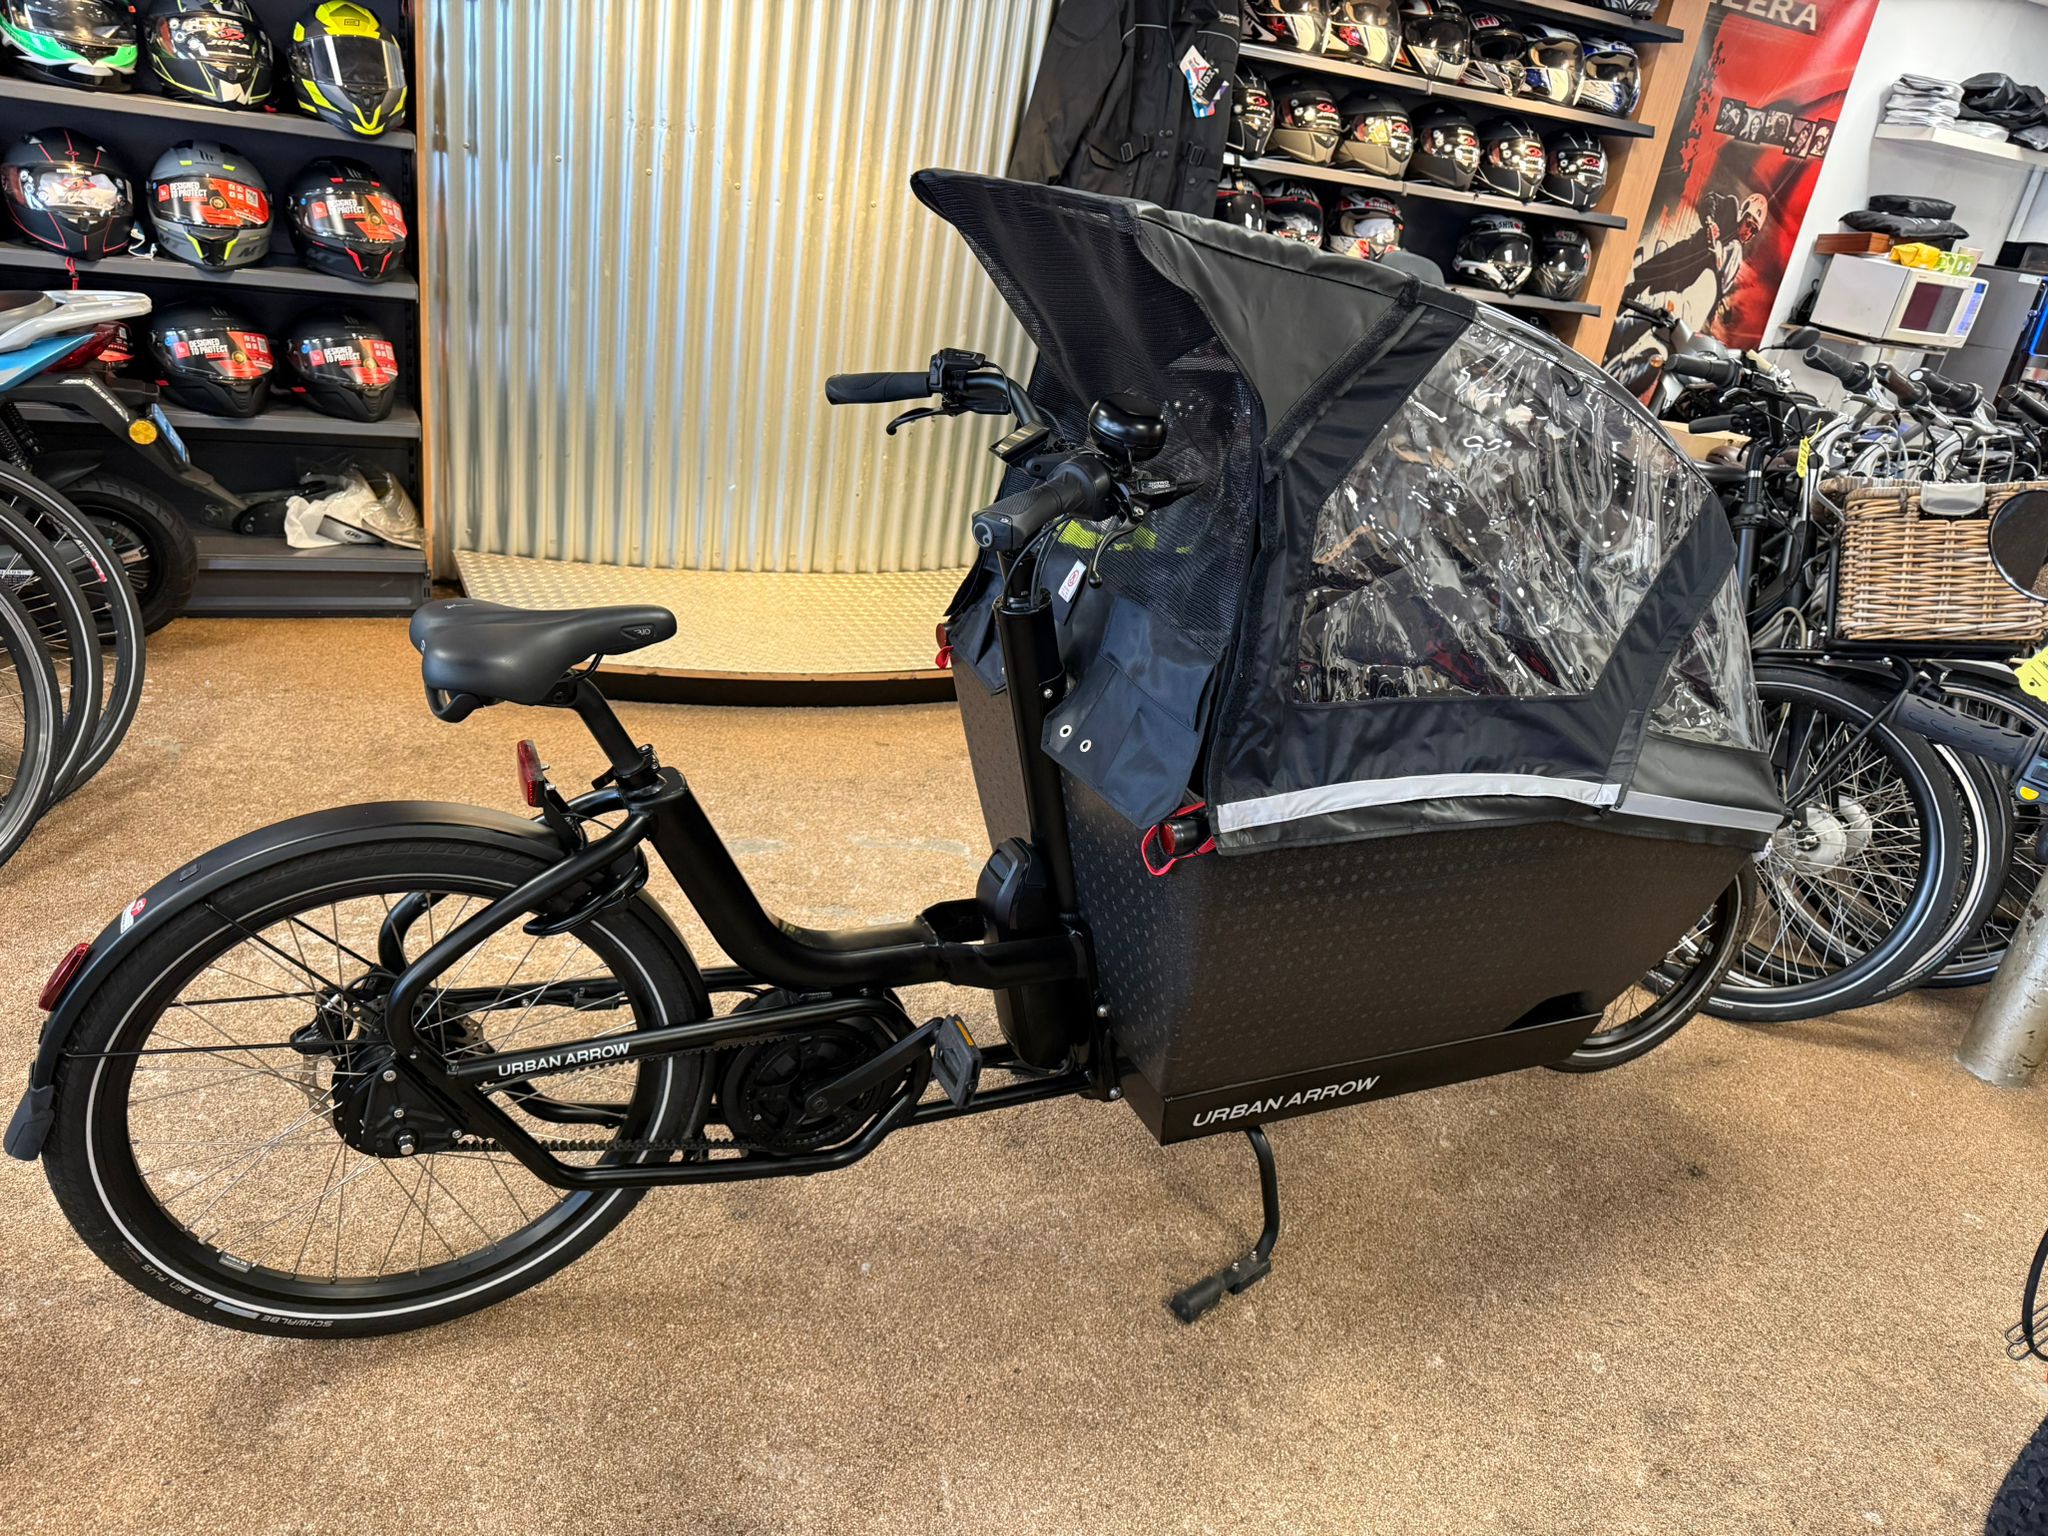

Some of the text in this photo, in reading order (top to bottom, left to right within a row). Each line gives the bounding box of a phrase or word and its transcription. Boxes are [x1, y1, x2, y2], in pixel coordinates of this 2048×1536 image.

[1708, 0, 1817, 32] LERA
[170, 182, 200, 191] DESIGNED
[178, 189, 207, 198] PROTECT
[188, 337, 220, 348] DESIGNED
[190, 346, 199, 356] TO
[199, 344, 228, 355] PROTECT
[324, 346, 353, 355] DESIGNED
[333, 352, 360, 361] PROTECT
[498, 1042, 630, 1076] URBAN ARROW
[1192, 1075, 1380, 1127] URBAN ARROW
[141, 1264, 168, 1282] PLUS
[193, 1294, 214, 1305] BIG
[262, 1314, 334, 1328] SCHWALBE
